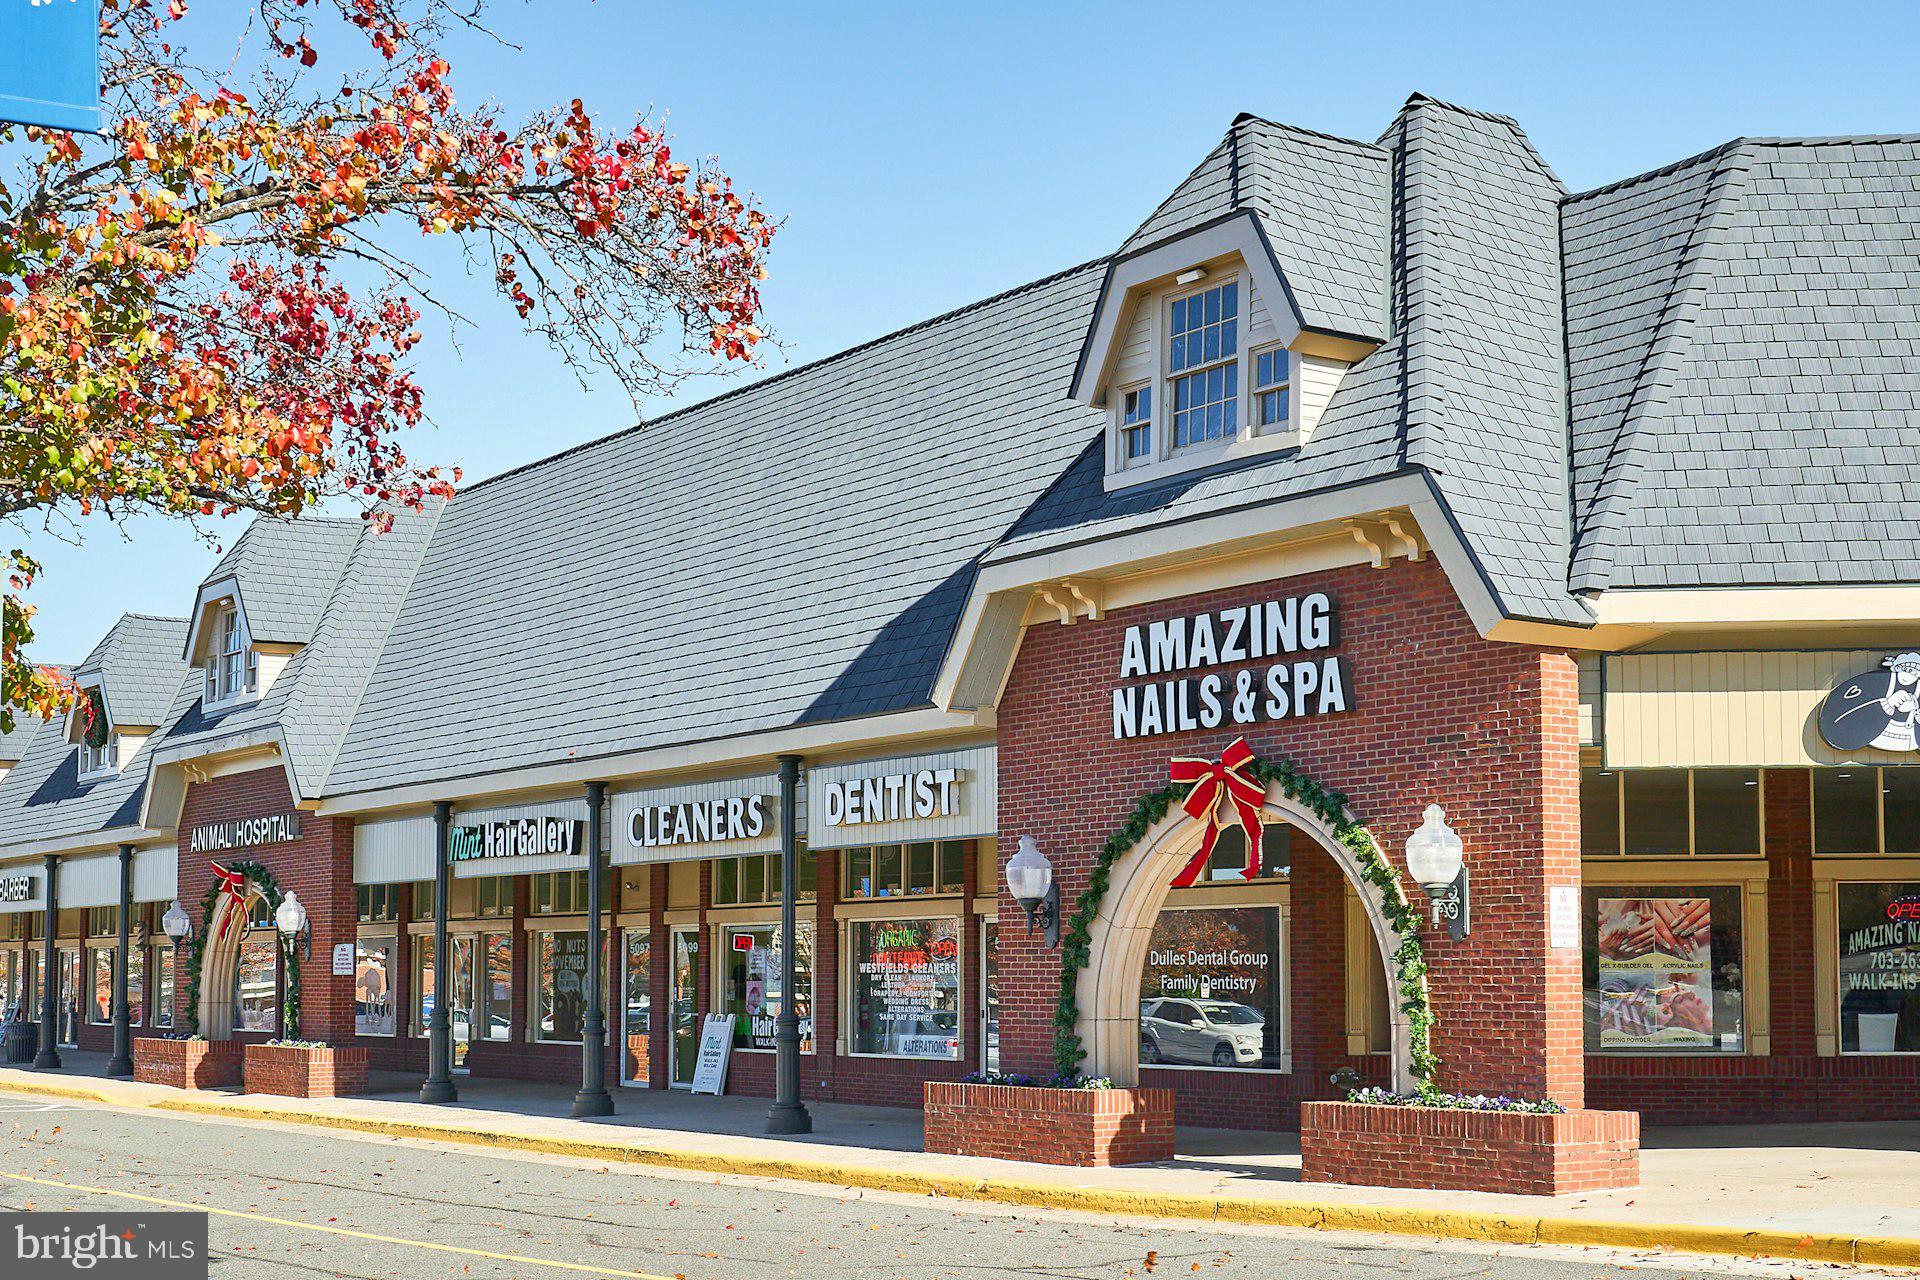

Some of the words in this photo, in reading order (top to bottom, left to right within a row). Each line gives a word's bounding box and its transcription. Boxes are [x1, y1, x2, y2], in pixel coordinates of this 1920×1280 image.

[1120, 593, 1330, 678] AMAZING
[1113, 674, 1223, 739] NAILS
[1232, 669, 1256, 724] &
[1265, 656, 1346, 720] SPA
[824, 768, 957, 827] DENTIST
[626, 794, 764, 848] CLEANERS
[190, 823, 231, 852] ANIMAL
[236, 814, 294, 847] HOSPITAL
[449, 823, 483, 861] Mint
[0, 876, 30, 900] BARBER
[566, 938, 586, 953] NUTS
[677, 941, 699, 954] 5099
[879, 929, 919, 948] ORGANIC
[1848, 922, 1903, 956] AMAZING
[629, 942, 650, 955] 5097
[931, 940, 958, 957] OPEN
[859, 963, 909, 974] WESTFIELDS
[912, 962, 957, 975] CLEANERS
[1150, 950, 1186, 966] Dulles
[1188, 950, 1227, 966] Dental
[1230, 951, 1269, 969] Group
[1161, 974, 1199, 993] Family
[1201, 974, 1257, 994] Dentistry
[1849, 972, 1917, 991] WALK-INS
[911, 997, 929, 1005] DRESS
[879, 1013, 895, 1021] SAME
[897, 1013, 908, 1021] DAY
[909, 1013, 933, 1021] SERVICE
[903, 1040, 948, 1053] ALTERATIONS
